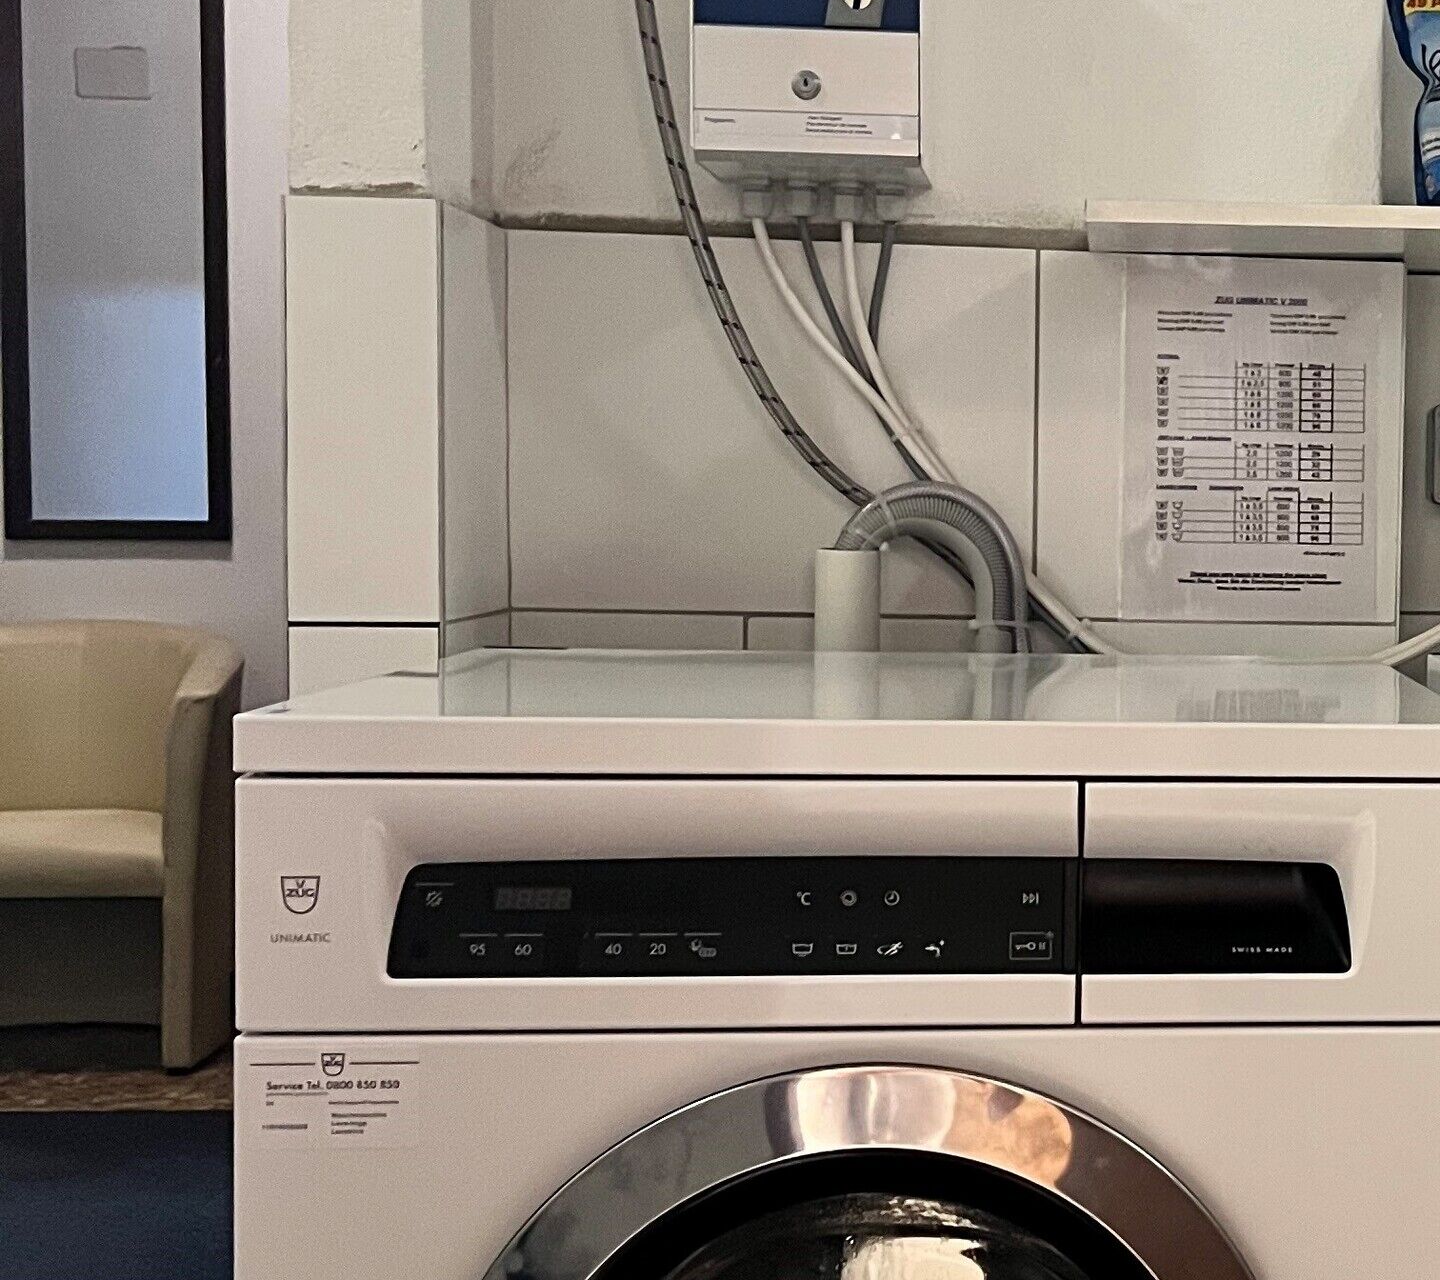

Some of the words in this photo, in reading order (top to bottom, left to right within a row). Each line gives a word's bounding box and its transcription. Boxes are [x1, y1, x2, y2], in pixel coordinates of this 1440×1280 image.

[270, 932, 332, 943] UNIMATIC
[469, 943, 486, 956] 95
[514, 943, 532, 956] 60
[605, 943, 622, 955] 40
[650, 943, 667, 955] 20
[266, 1081, 303, 1090] Service
[326, 1081, 353, 1090] 0800
